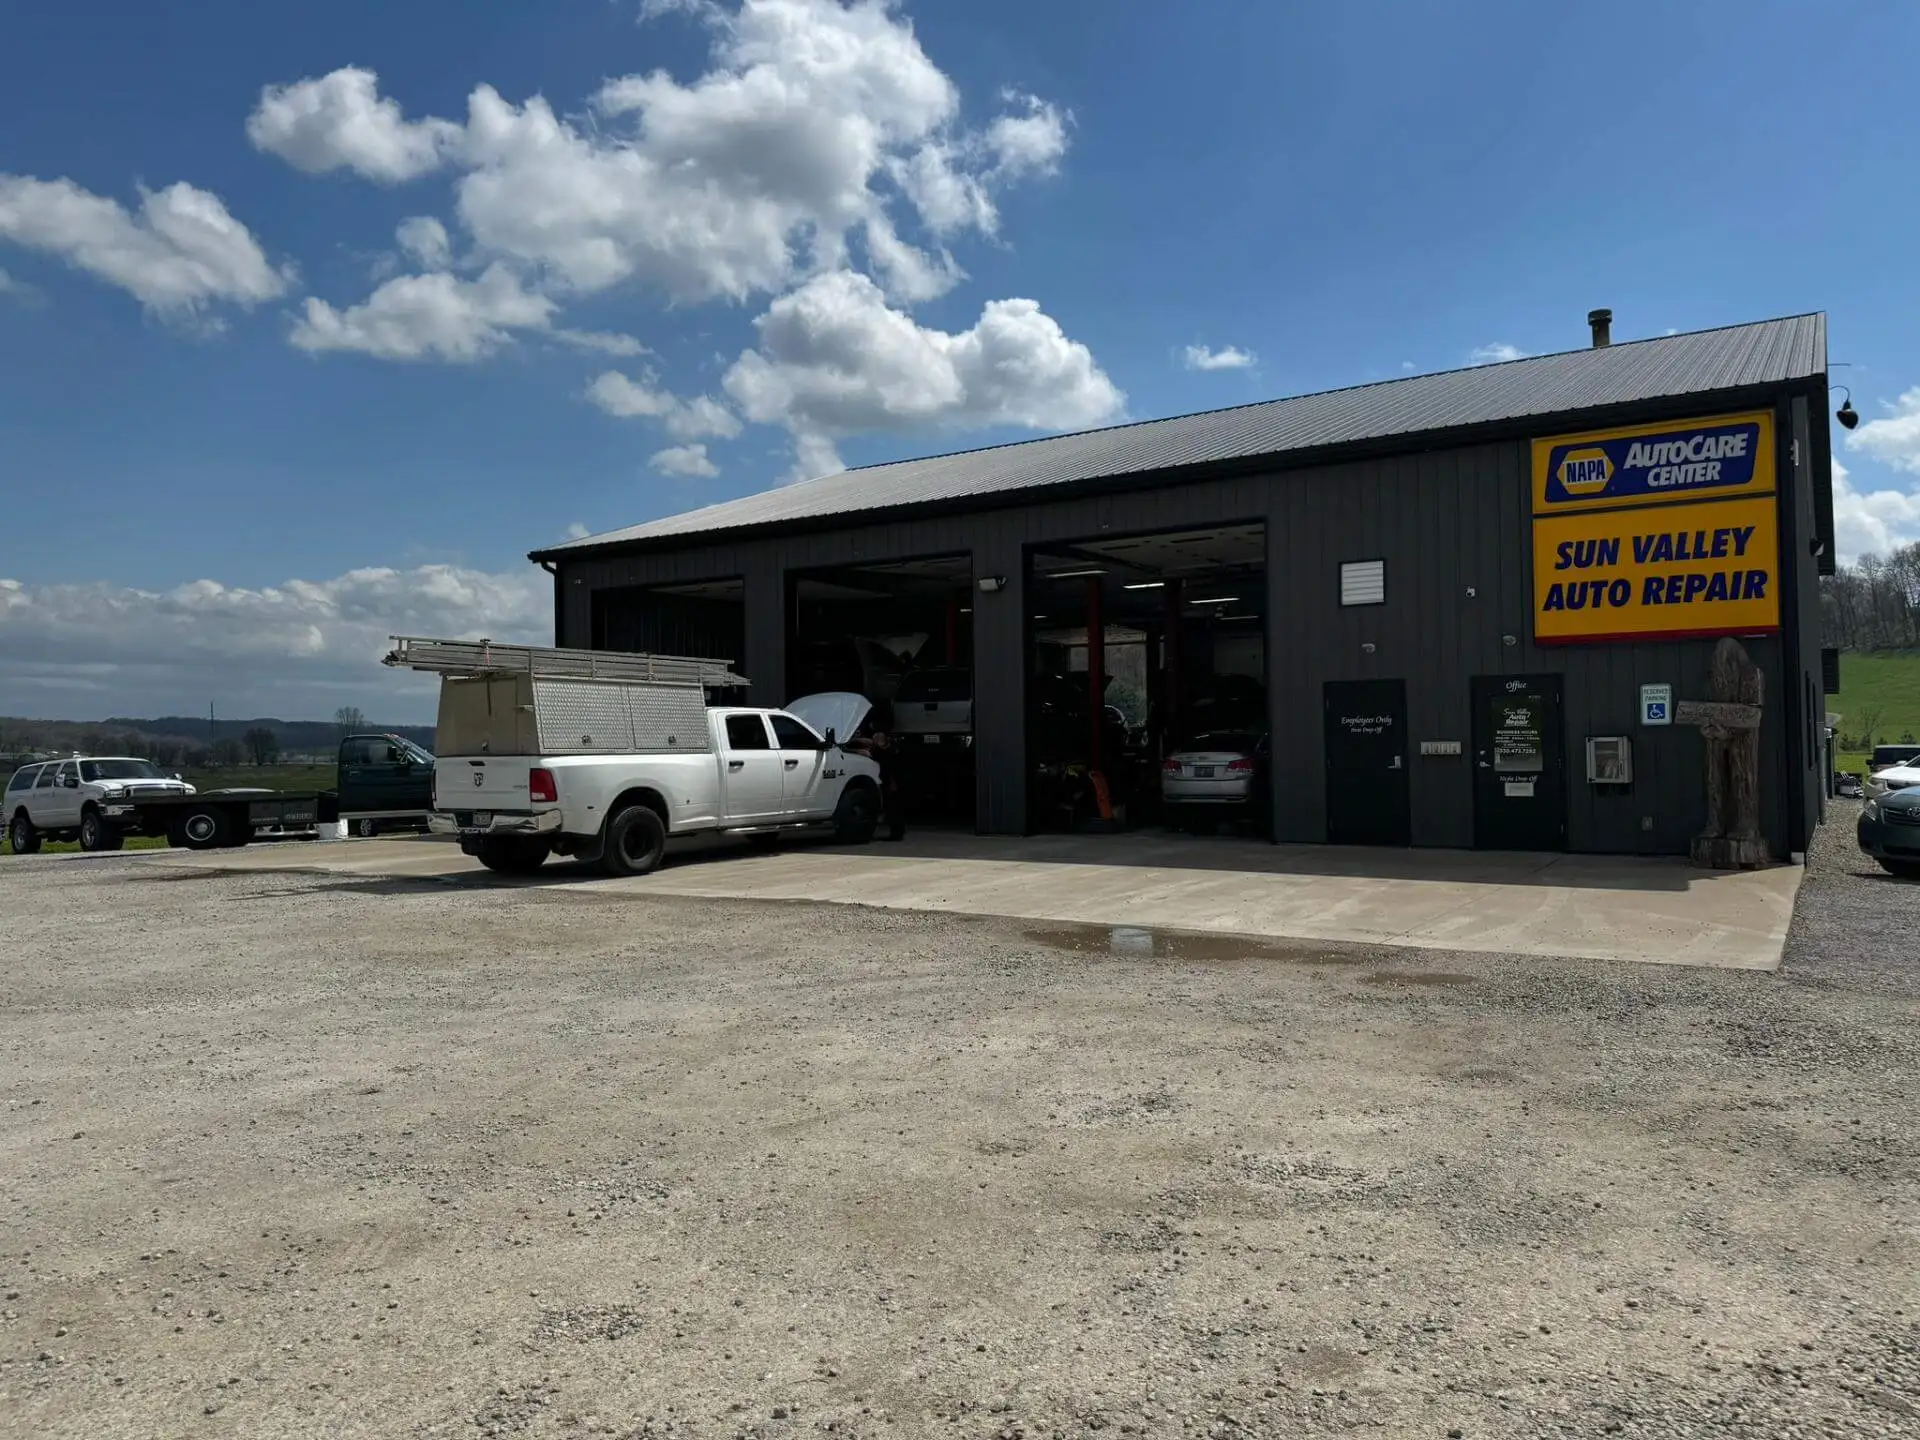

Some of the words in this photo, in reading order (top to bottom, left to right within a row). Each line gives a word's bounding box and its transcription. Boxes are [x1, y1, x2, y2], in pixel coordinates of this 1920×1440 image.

[1566, 459, 1606, 483] NAPA
[1647, 462, 1721, 487] CENTER
[1554, 537, 1620, 570] SUN
[1632, 526, 1755, 564] VALLEY
[1542, 578, 1631, 611] AUTO
[1641, 570, 1768, 605] REPAIR
[1506, 680, 1527, 692] Office
[1341, 715, 1375, 727] Employees
[1375, 715, 1392, 727] Only
